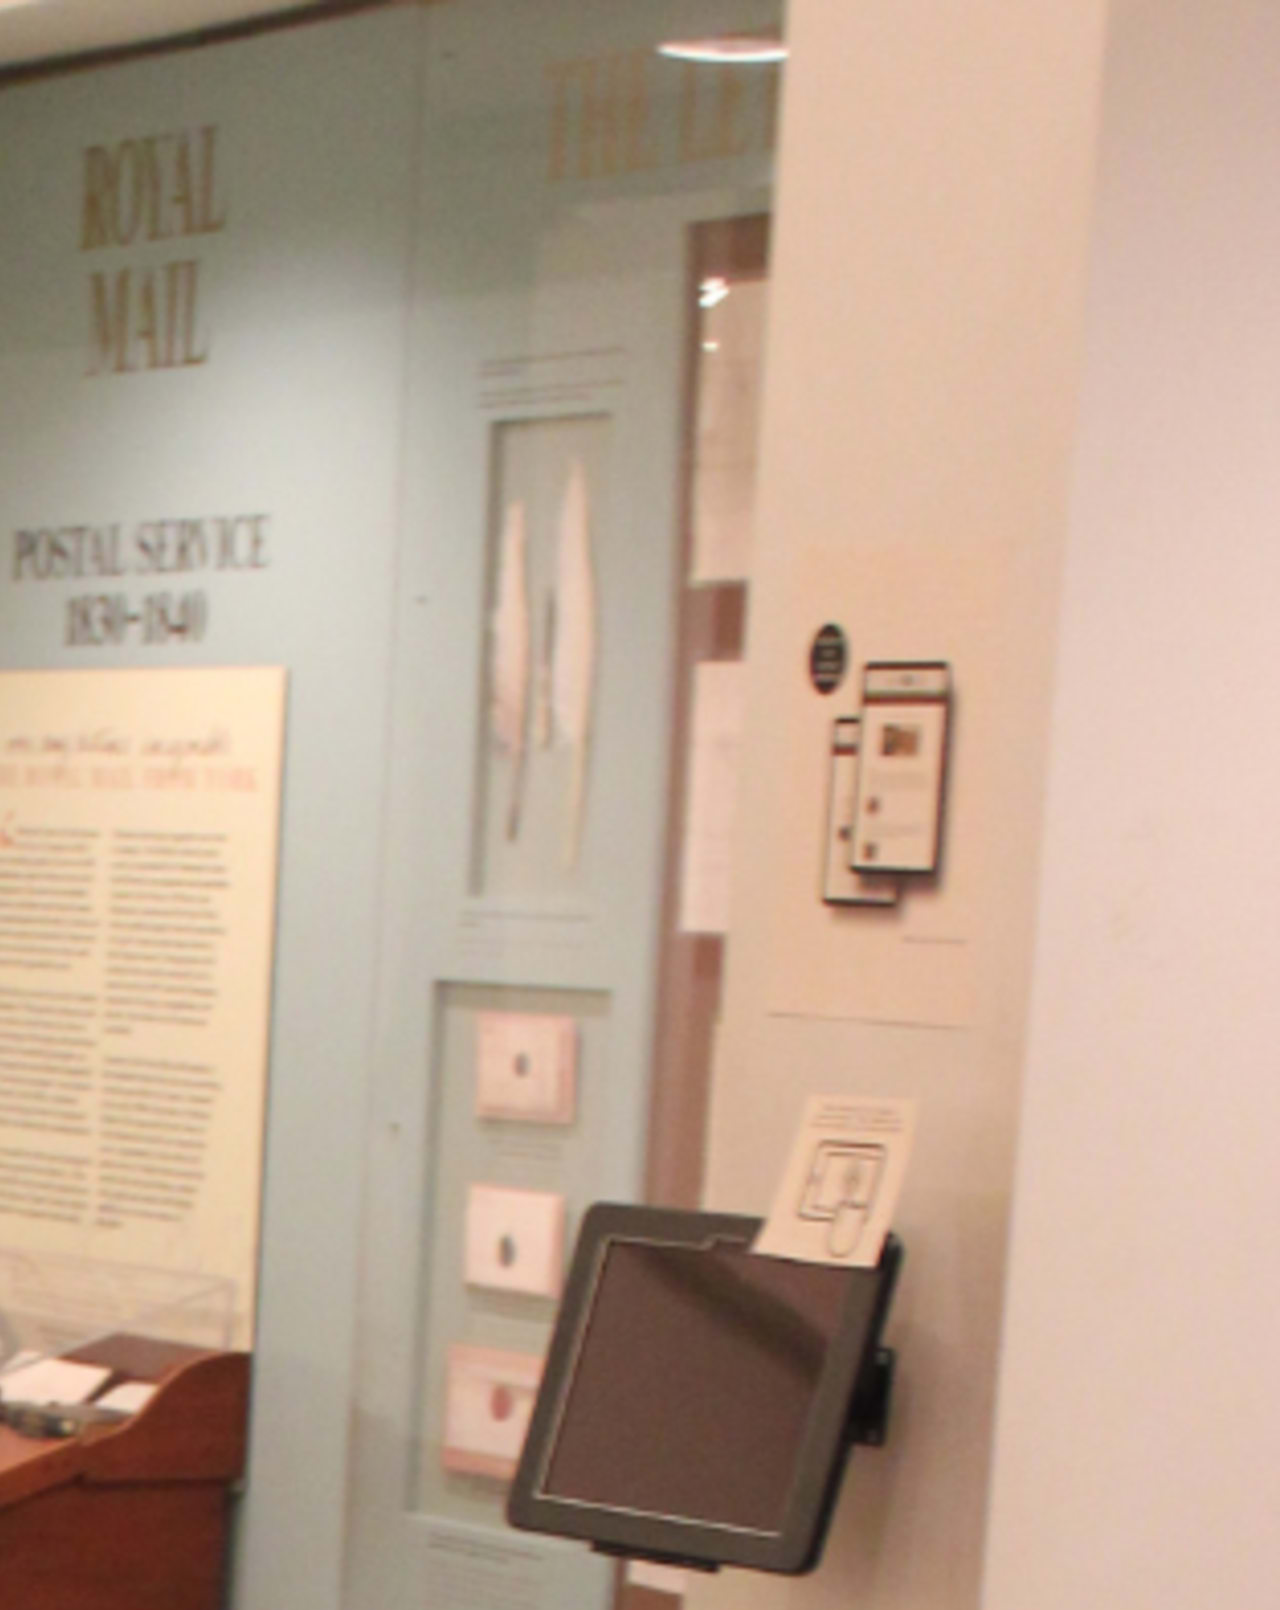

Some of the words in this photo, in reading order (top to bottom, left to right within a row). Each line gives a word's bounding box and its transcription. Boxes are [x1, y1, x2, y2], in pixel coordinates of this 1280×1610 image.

[80, 125, 225, 251] ROYAL
[83, 259, 208, 377] MAIL
[13, 524, 125, 582] POSTAL
[135, 513, 269, 575] SERVICE
